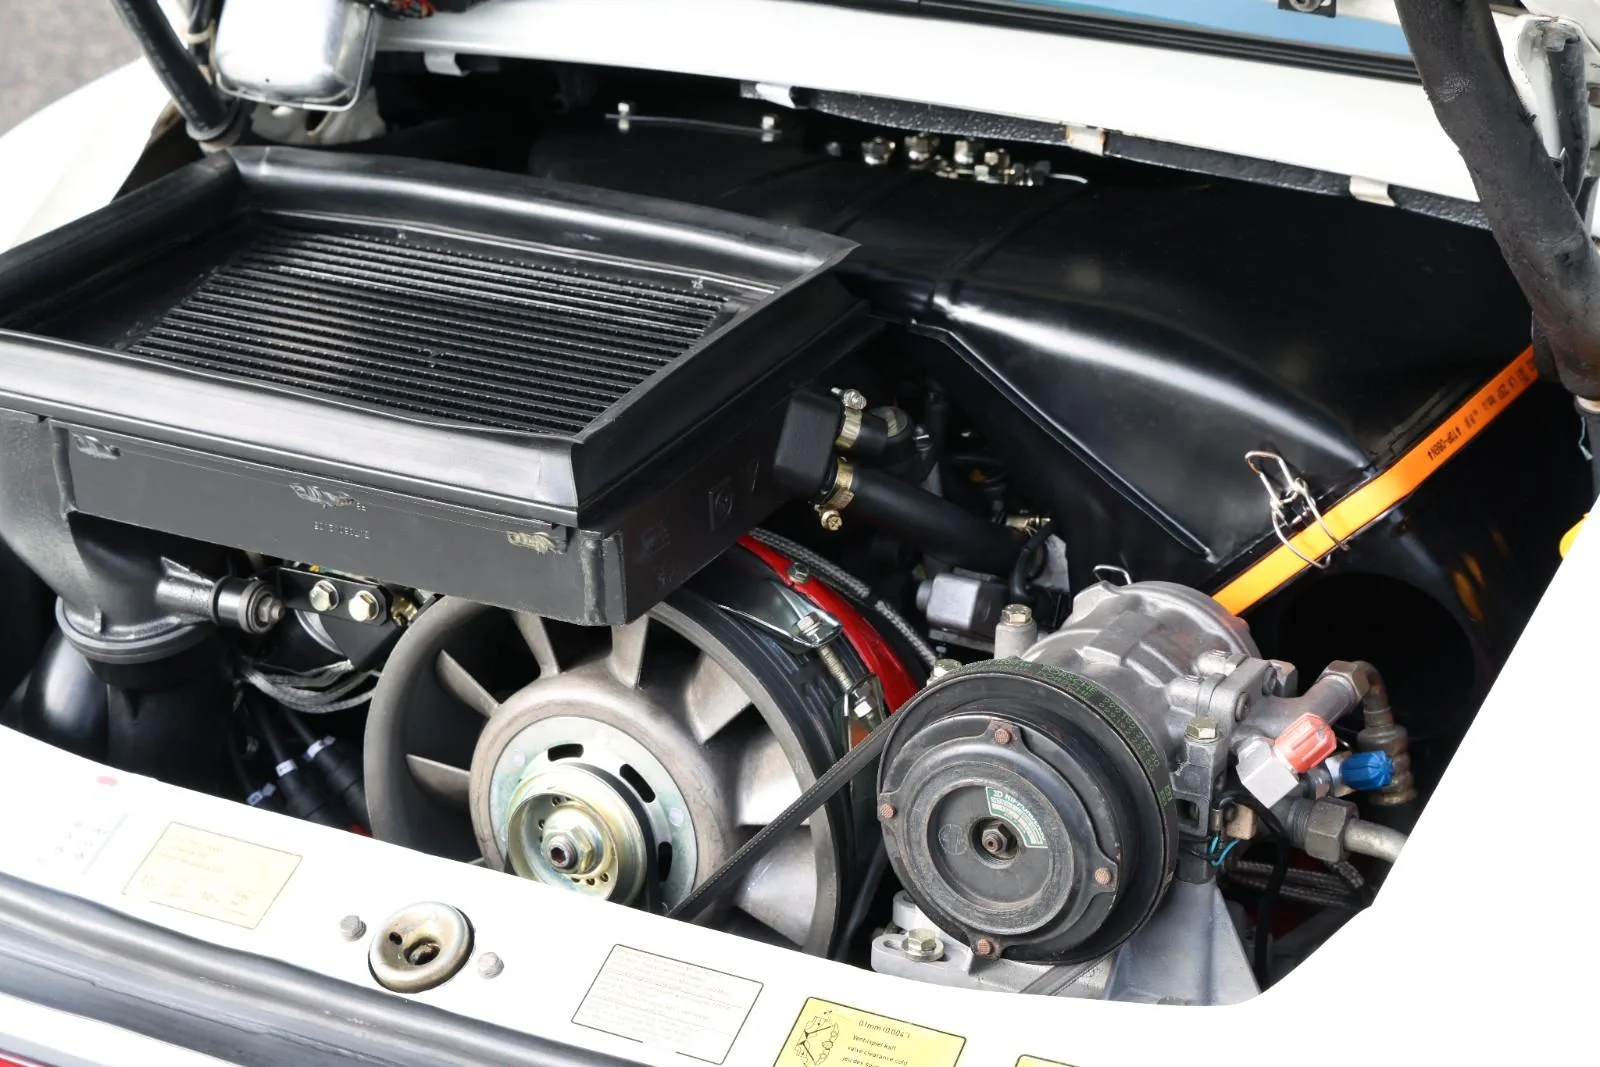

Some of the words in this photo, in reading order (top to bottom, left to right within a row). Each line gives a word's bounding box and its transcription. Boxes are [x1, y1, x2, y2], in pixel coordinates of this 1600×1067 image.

[847, 1046, 863, 1054] valve
[863, 1050, 894, 1062] clearance
[894, 1058, 908, 1066] cold
